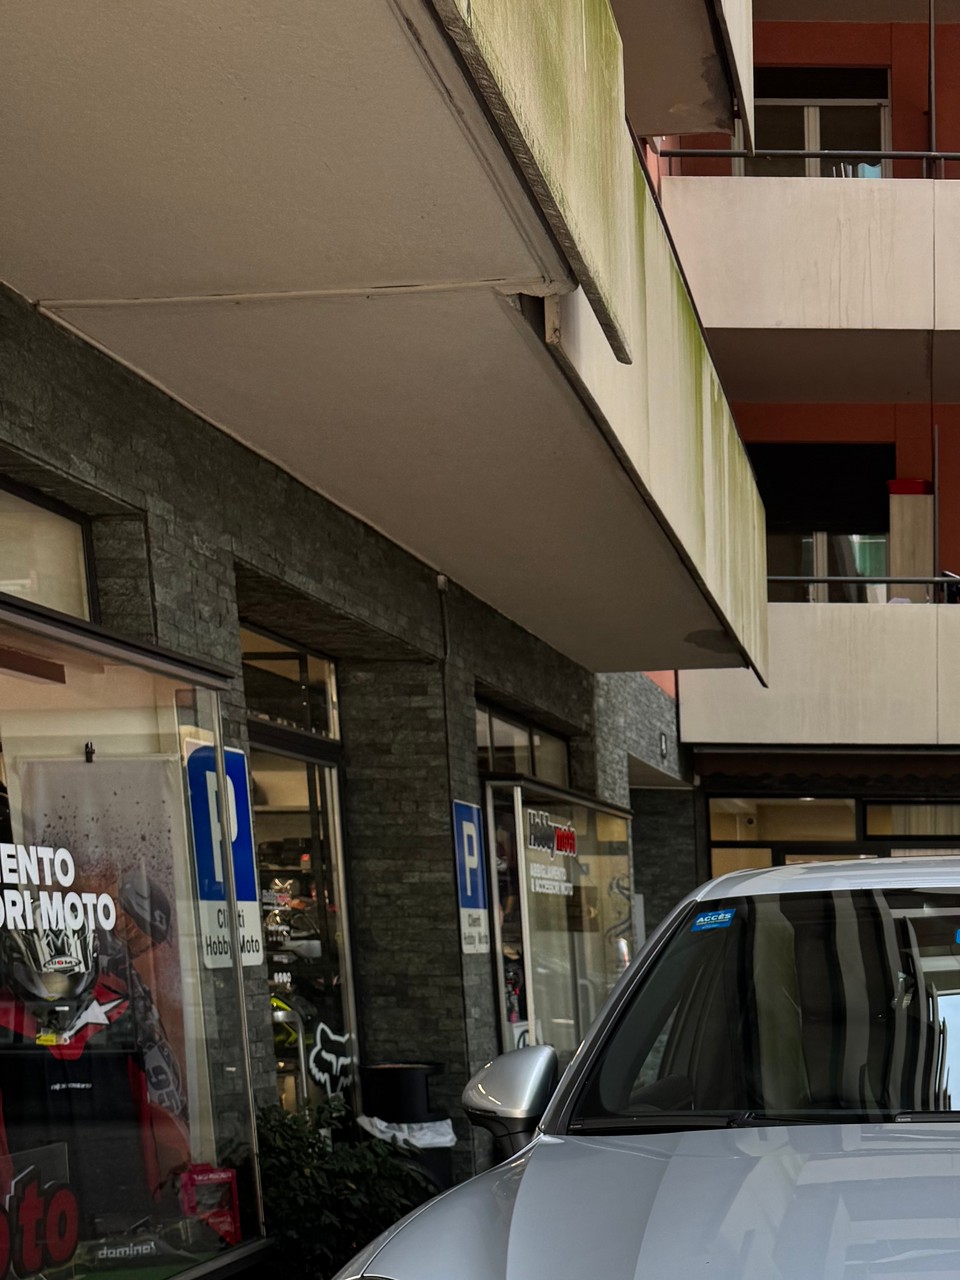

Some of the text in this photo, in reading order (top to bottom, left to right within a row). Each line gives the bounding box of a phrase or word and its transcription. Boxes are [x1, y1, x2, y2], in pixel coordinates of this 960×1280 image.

[205, 770, 239, 882] P
[0, 843, 75, 887] ENTO
[462, 821, 479, 896] P
[0, 889, 116, 930] RI MOTO
